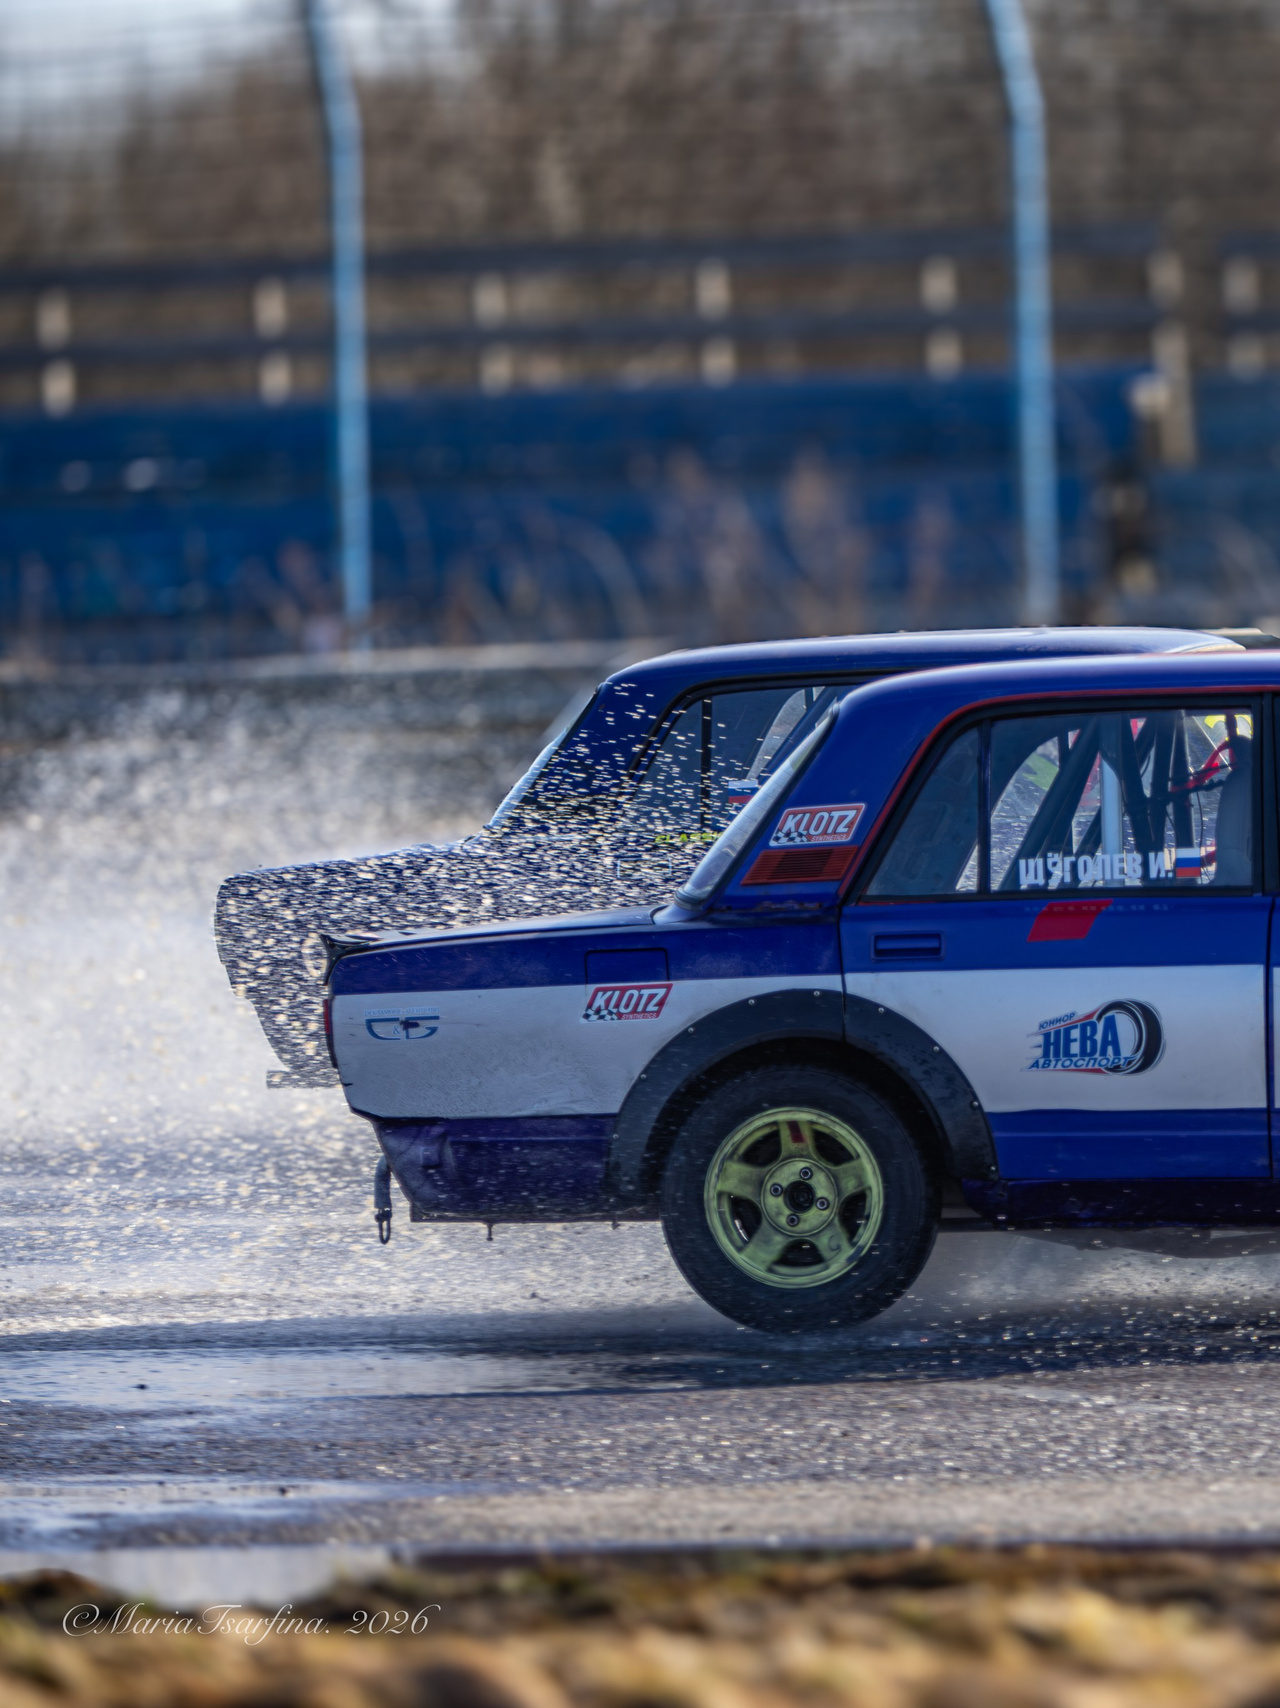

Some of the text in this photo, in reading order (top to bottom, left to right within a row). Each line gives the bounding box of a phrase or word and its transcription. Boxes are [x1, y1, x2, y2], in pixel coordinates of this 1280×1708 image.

[782, 809, 858, 835] KLOTZ
[811, 833, 847, 842] SYNTHETICS
[591, 988, 667, 1013] KLOTZ
[621, 1012, 657, 1020] SYNTHETICS
[1038, 1012, 1076, 1031] ЮНИОР
[1042, 1014, 1122, 1059] НЕВА
[1028, 1056, 1134, 1070] АВТОСПОРТ
